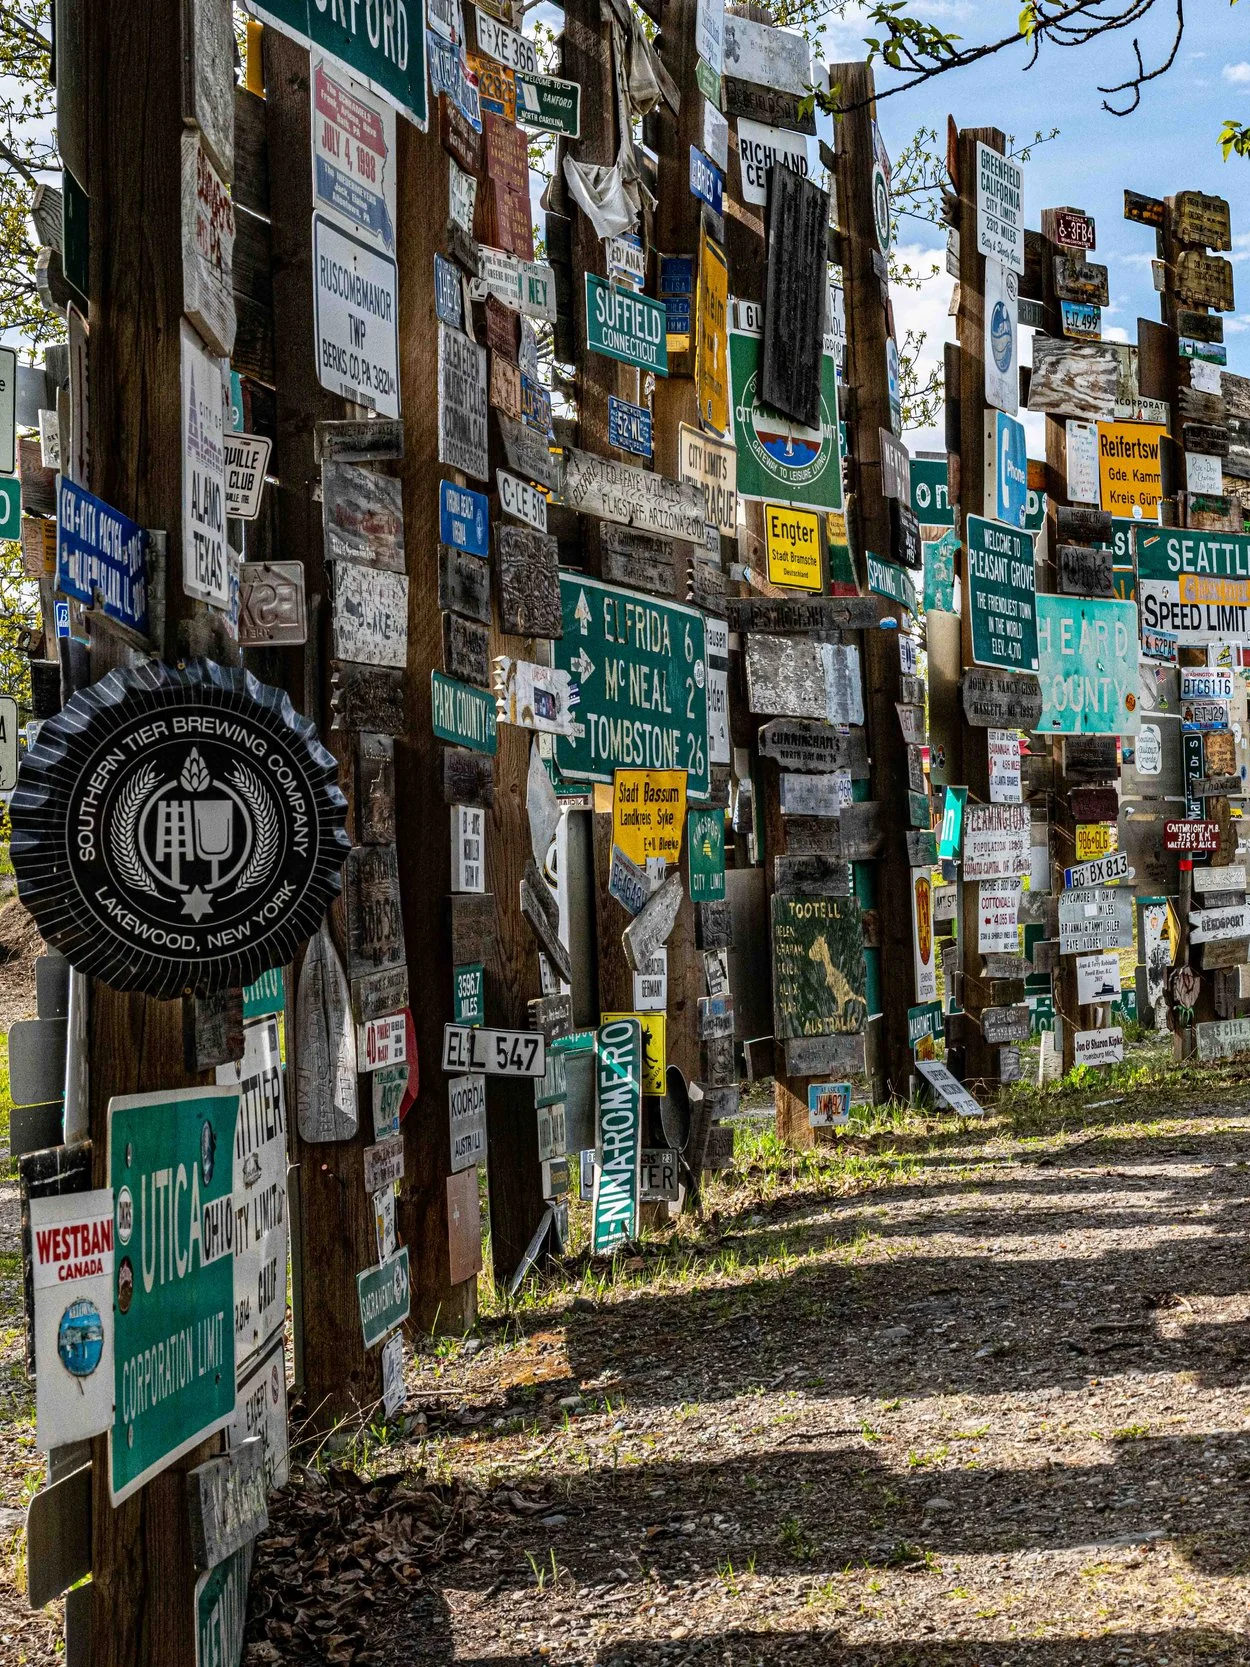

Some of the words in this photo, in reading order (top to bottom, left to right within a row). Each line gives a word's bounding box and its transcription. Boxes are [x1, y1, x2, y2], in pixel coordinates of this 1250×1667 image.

[740, 138, 807, 177] RICHLAND
[981, 149, 1020, 188] GREENFIELD
[981, 171, 1020, 211] CALIFORNIA
[986, 197, 998, 212] CITY
[1000, 202, 1016, 224] LIMITS
[986, 216, 999, 236] 2312
[1001, 224, 1016, 244] MILES
[320, 255, 391, 323] RUSCOMBMANOR
[596, 286, 661, 344] SUFFIELD
[602, 328, 657, 363] CONNECTICUT
[689, 443, 702, 468] CITY
[704, 451, 727, 480] LIMITS
[753, 440, 778, 472] GATEWAY
[780, 468, 787, 477] TO
[789, 464, 812, 480] LEISURE
[812, 453, 826, 474] LIVING
[1007, 462, 1025, 484] Phone
[192, 469, 224, 537] ALAMO,
[772, 515, 814, 546] Engter
[984, 528, 1011, 553] WELCOME
[1013, 538, 1021, 555] TO
[194, 531, 222, 592] TEXAS
[772, 549, 788, 562] Stadt
[791, 552, 817, 567] Bramsche
[784, 568, 809, 578] Deutschland
[969, 549, 1008, 584] PLEASANT
[1010, 560, 1035, 590] GROVE
[869, 561, 895, 596] SPRING
[604, 597, 671, 657] ELFRIDA
[1145, 594, 1201, 630] SPEED
[1207, 605, 1247, 632] LIMIT
[1036, 618, 1127, 656] HEARD
[629, 663, 672, 714] NEAL
[1042, 675, 1127, 713] COUNTY
[1184, 679, 1231, 695] BTC6116
[433, 681, 455, 724] PARK
[456, 691, 486, 742] COUNTY
[587, 713, 681, 769] TOMBSTONE
[687, 735, 704, 776] 26
[75, 748, 127, 862] SOUTHERN
[122, 722, 170, 751] TIER
[172, 717, 267, 756] BREWING
[267, 754, 309, 857] COMPANY
[619, 781, 638, 803] Stadt
[644, 784, 679, 804] Bassum
[620, 806, 651, 826] Landkreis
[657, 809, 673, 826] Syke
[971, 806, 1025, 832] LEAMINGTON
[94, 886, 200, 952] LAKEWOOD,
[207, 923, 251, 948] NEW
[252, 881, 297, 925] YORK
[789, 902, 841, 918] TOOTELL
[458, 973, 480, 998] 3596.7
[461, 1000, 478, 1017] MILES
[804, 1017, 856, 1034] AUSTRALIA
[142, 1162, 199, 1293] UTICA
[203, 1197, 232, 1261] OHIO
[57, 1260, 103, 1282] CANADA
[122, 1327, 193, 1424] CORPORATION
[198, 1311, 224, 1377] LIMIT
